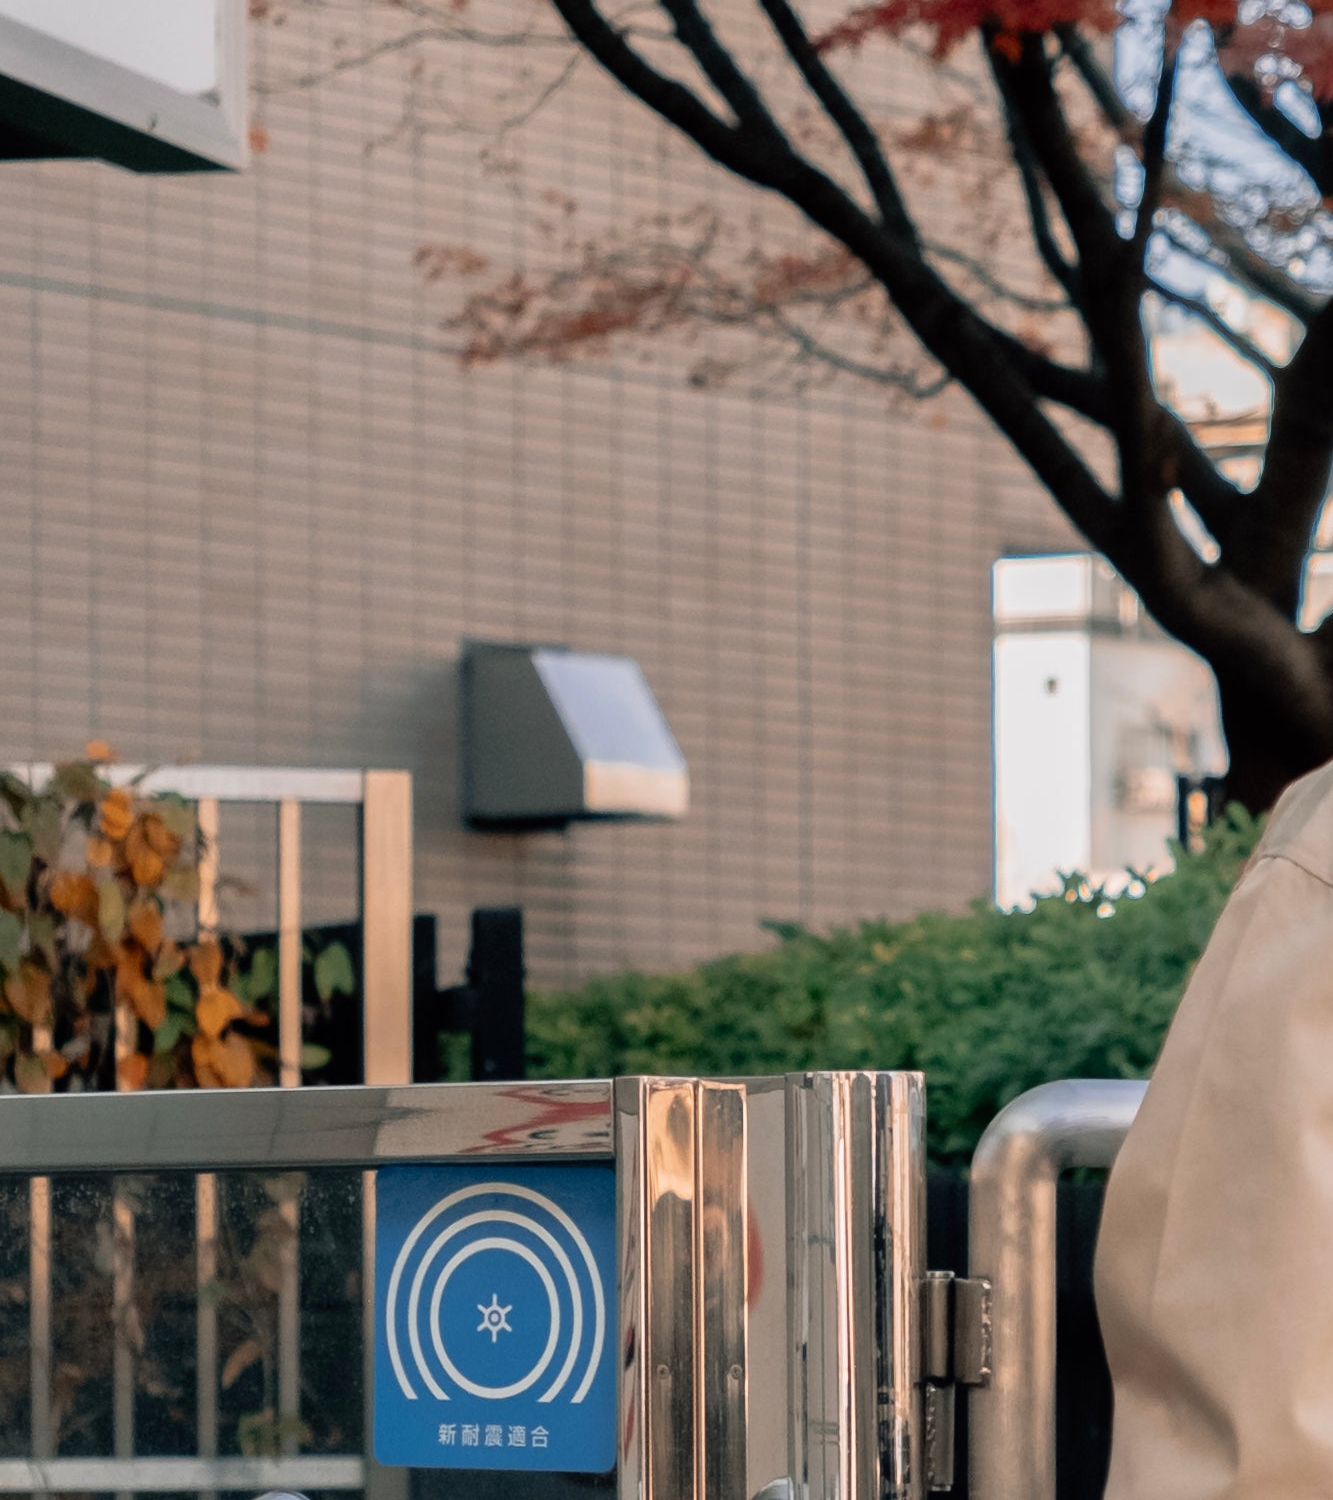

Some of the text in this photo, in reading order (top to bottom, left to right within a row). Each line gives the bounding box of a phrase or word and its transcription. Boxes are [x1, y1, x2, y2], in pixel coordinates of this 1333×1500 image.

[437, 1423, 550, 1449] 新耐震適合
